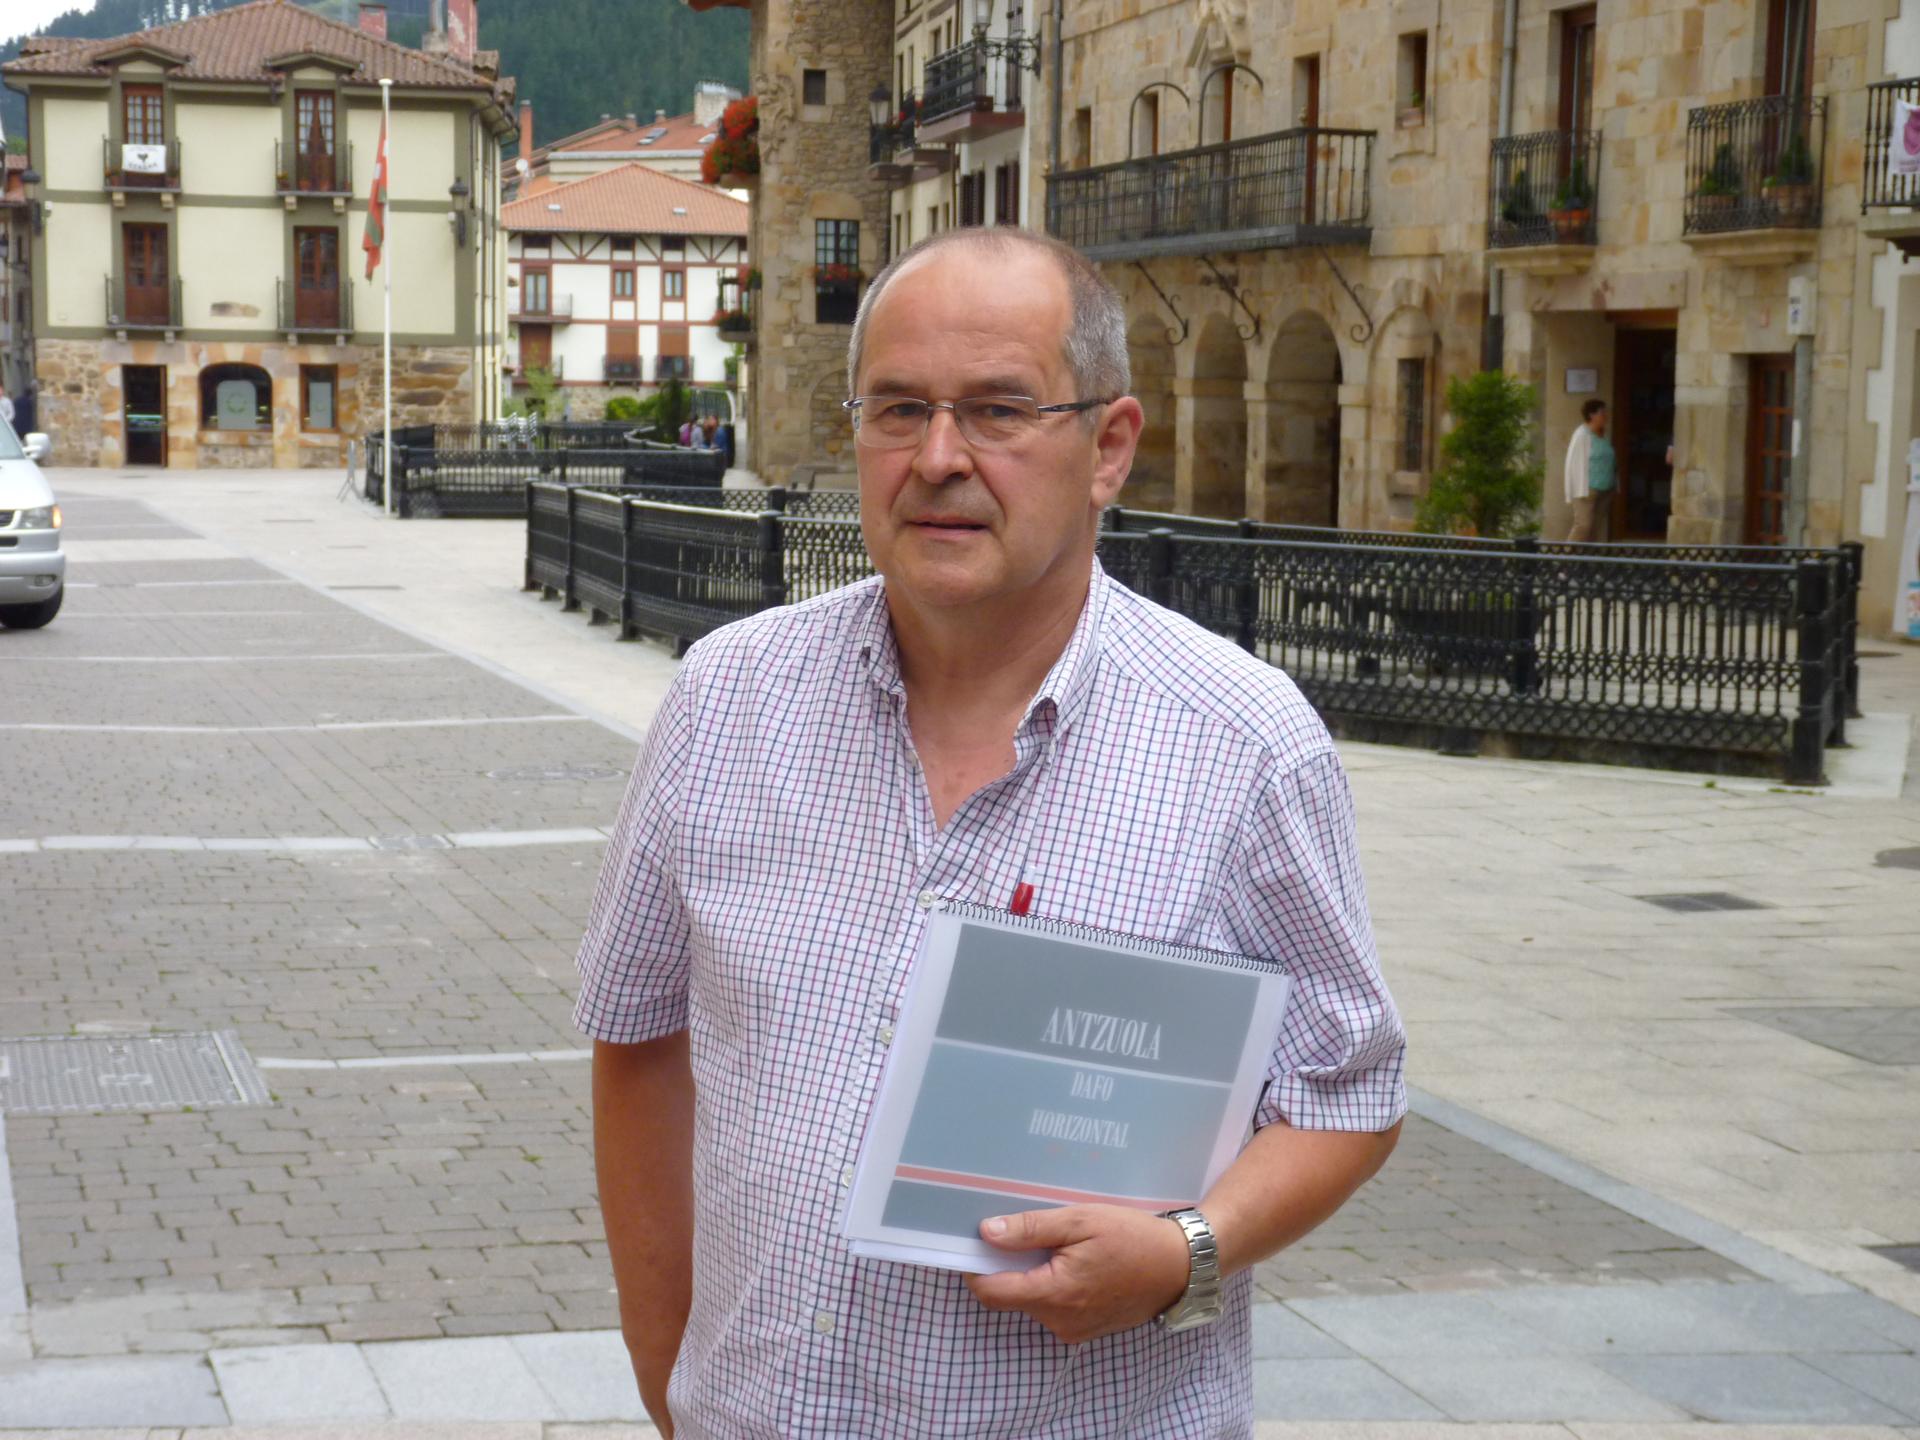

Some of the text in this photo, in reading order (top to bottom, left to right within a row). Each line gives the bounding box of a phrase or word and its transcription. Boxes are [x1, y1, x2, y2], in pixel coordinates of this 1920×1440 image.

[1040, 1006, 1161, 1060] ANTZUOLA
[1070, 1071, 1115, 1101] DAFO
[1028, 1108, 1130, 1148] HORIZONTAL
